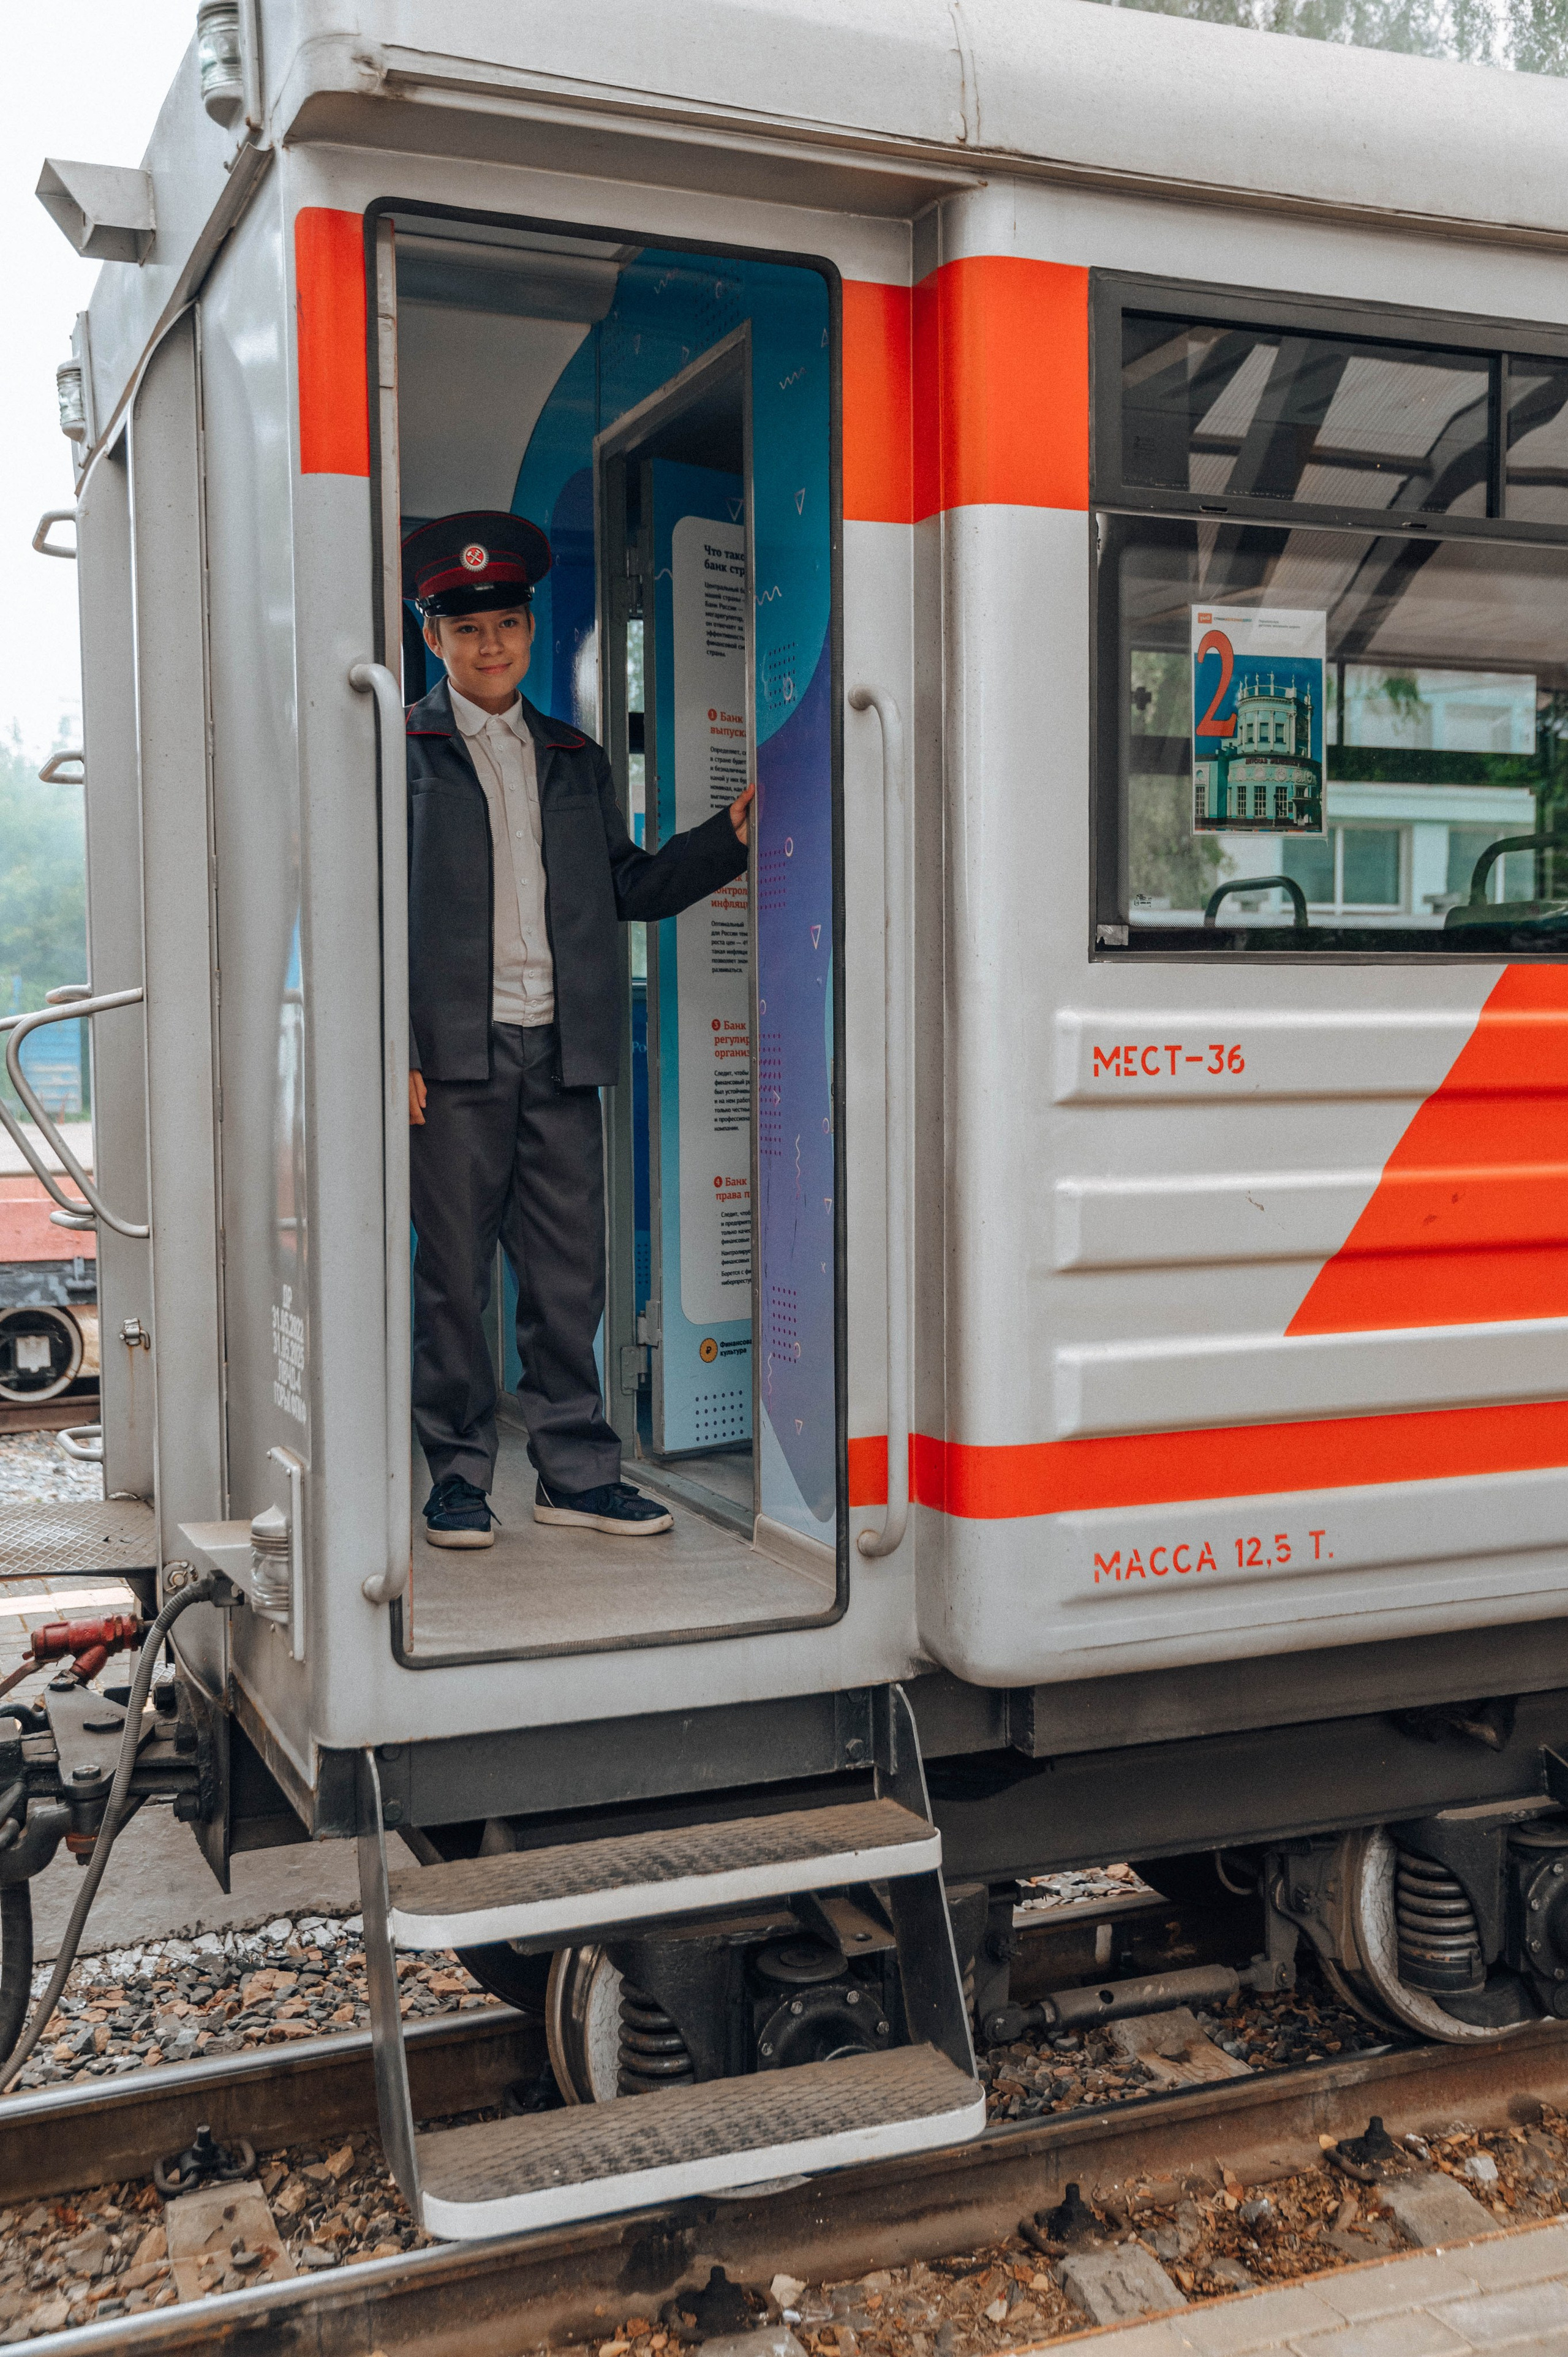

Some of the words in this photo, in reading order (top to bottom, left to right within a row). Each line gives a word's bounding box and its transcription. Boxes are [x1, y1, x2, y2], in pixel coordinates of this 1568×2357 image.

[704, 545, 722, 556] Что
[704, 559, 727, 572] банк
[704, 581, 739, 592] Центральный
[1196, 630, 1237, 737] 2
[720, 712, 744, 723] Банк
[723, 1020, 746, 1030] Банк
[1093, 1044, 1245, 1077] МЕСТ-36
[725, 1177, 747, 1186] Банк
[716, 1193, 742, 1202] права
[720, 1348, 747, 1357] культура
[1095, 1542, 1217, 1583] МАССА
[1235, 1534, 1291, 1567] 12,5
[1309, 1530, 1333, 1559] Т.
